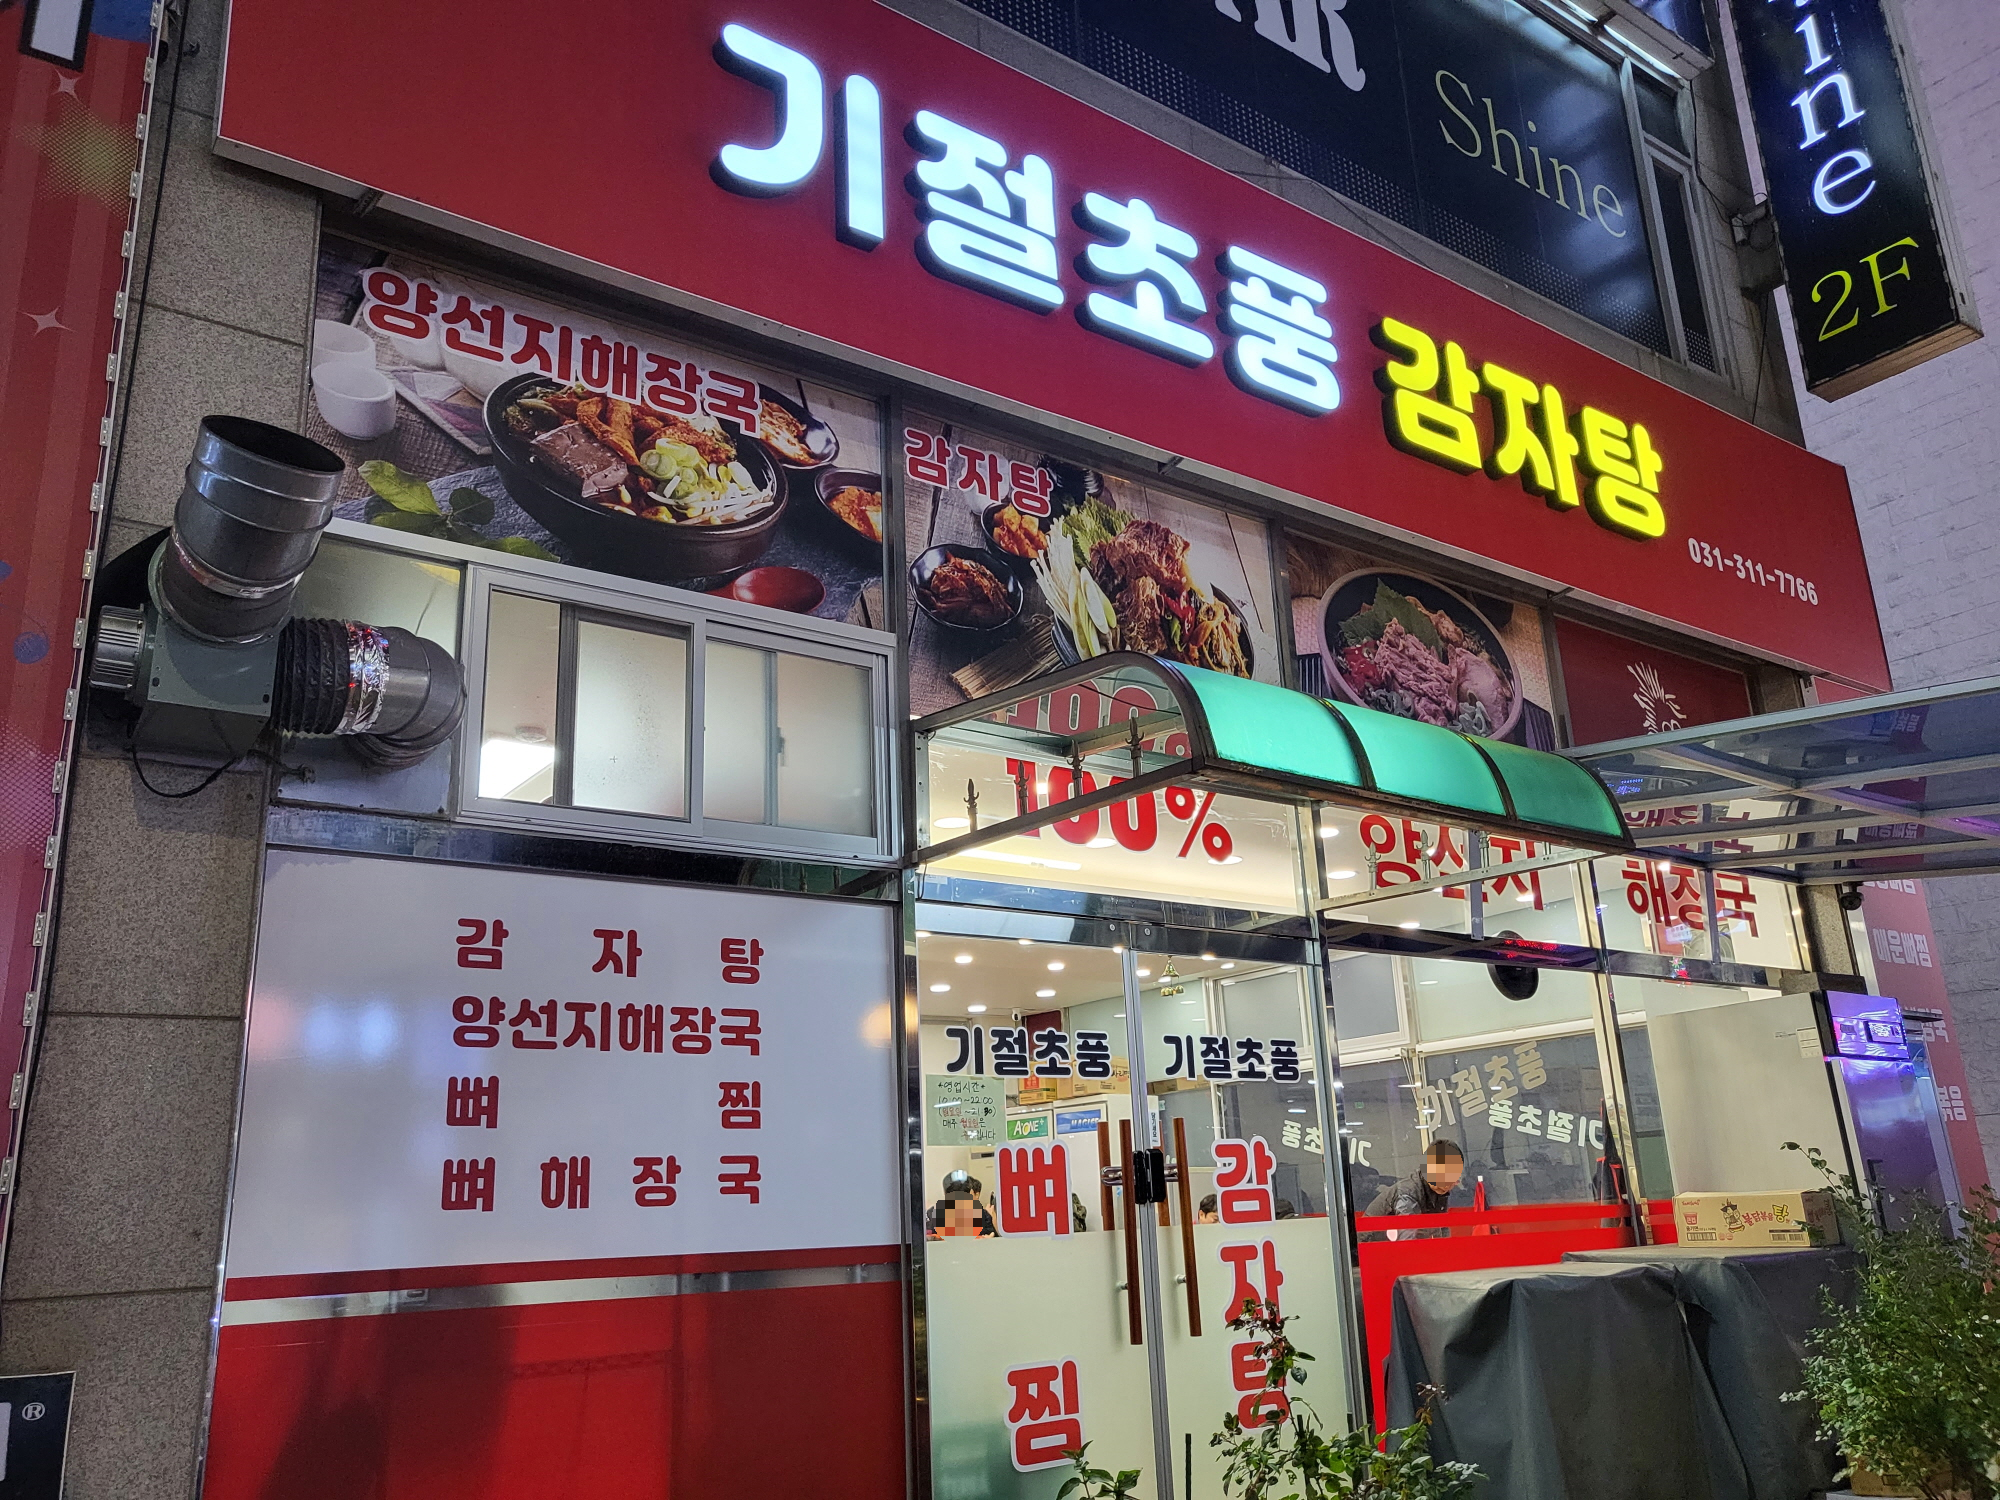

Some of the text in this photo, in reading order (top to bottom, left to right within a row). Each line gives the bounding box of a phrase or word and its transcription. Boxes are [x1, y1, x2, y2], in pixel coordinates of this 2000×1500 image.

[1435, 69, 1627, 238] Shine
[1789, 0, 1876, 215] ine
[716, 22, 1667, 538] 기절초풍 감자탕
[1811, 236, 1919, 342] 2F
[367, 269, 760, 436] 양선지해장국
[905, 428, 1053, 516] 감자탕
[1687, 537, 1820, 606] 031-311-7766
[1006, 757, 1233, 863] 100%
[452, 995, 762, 1056] 양선지해장국
[946, 1026, 1111, 1077] 기절초풍
[1164, 1034, 1300, 1081] 기절초풍
